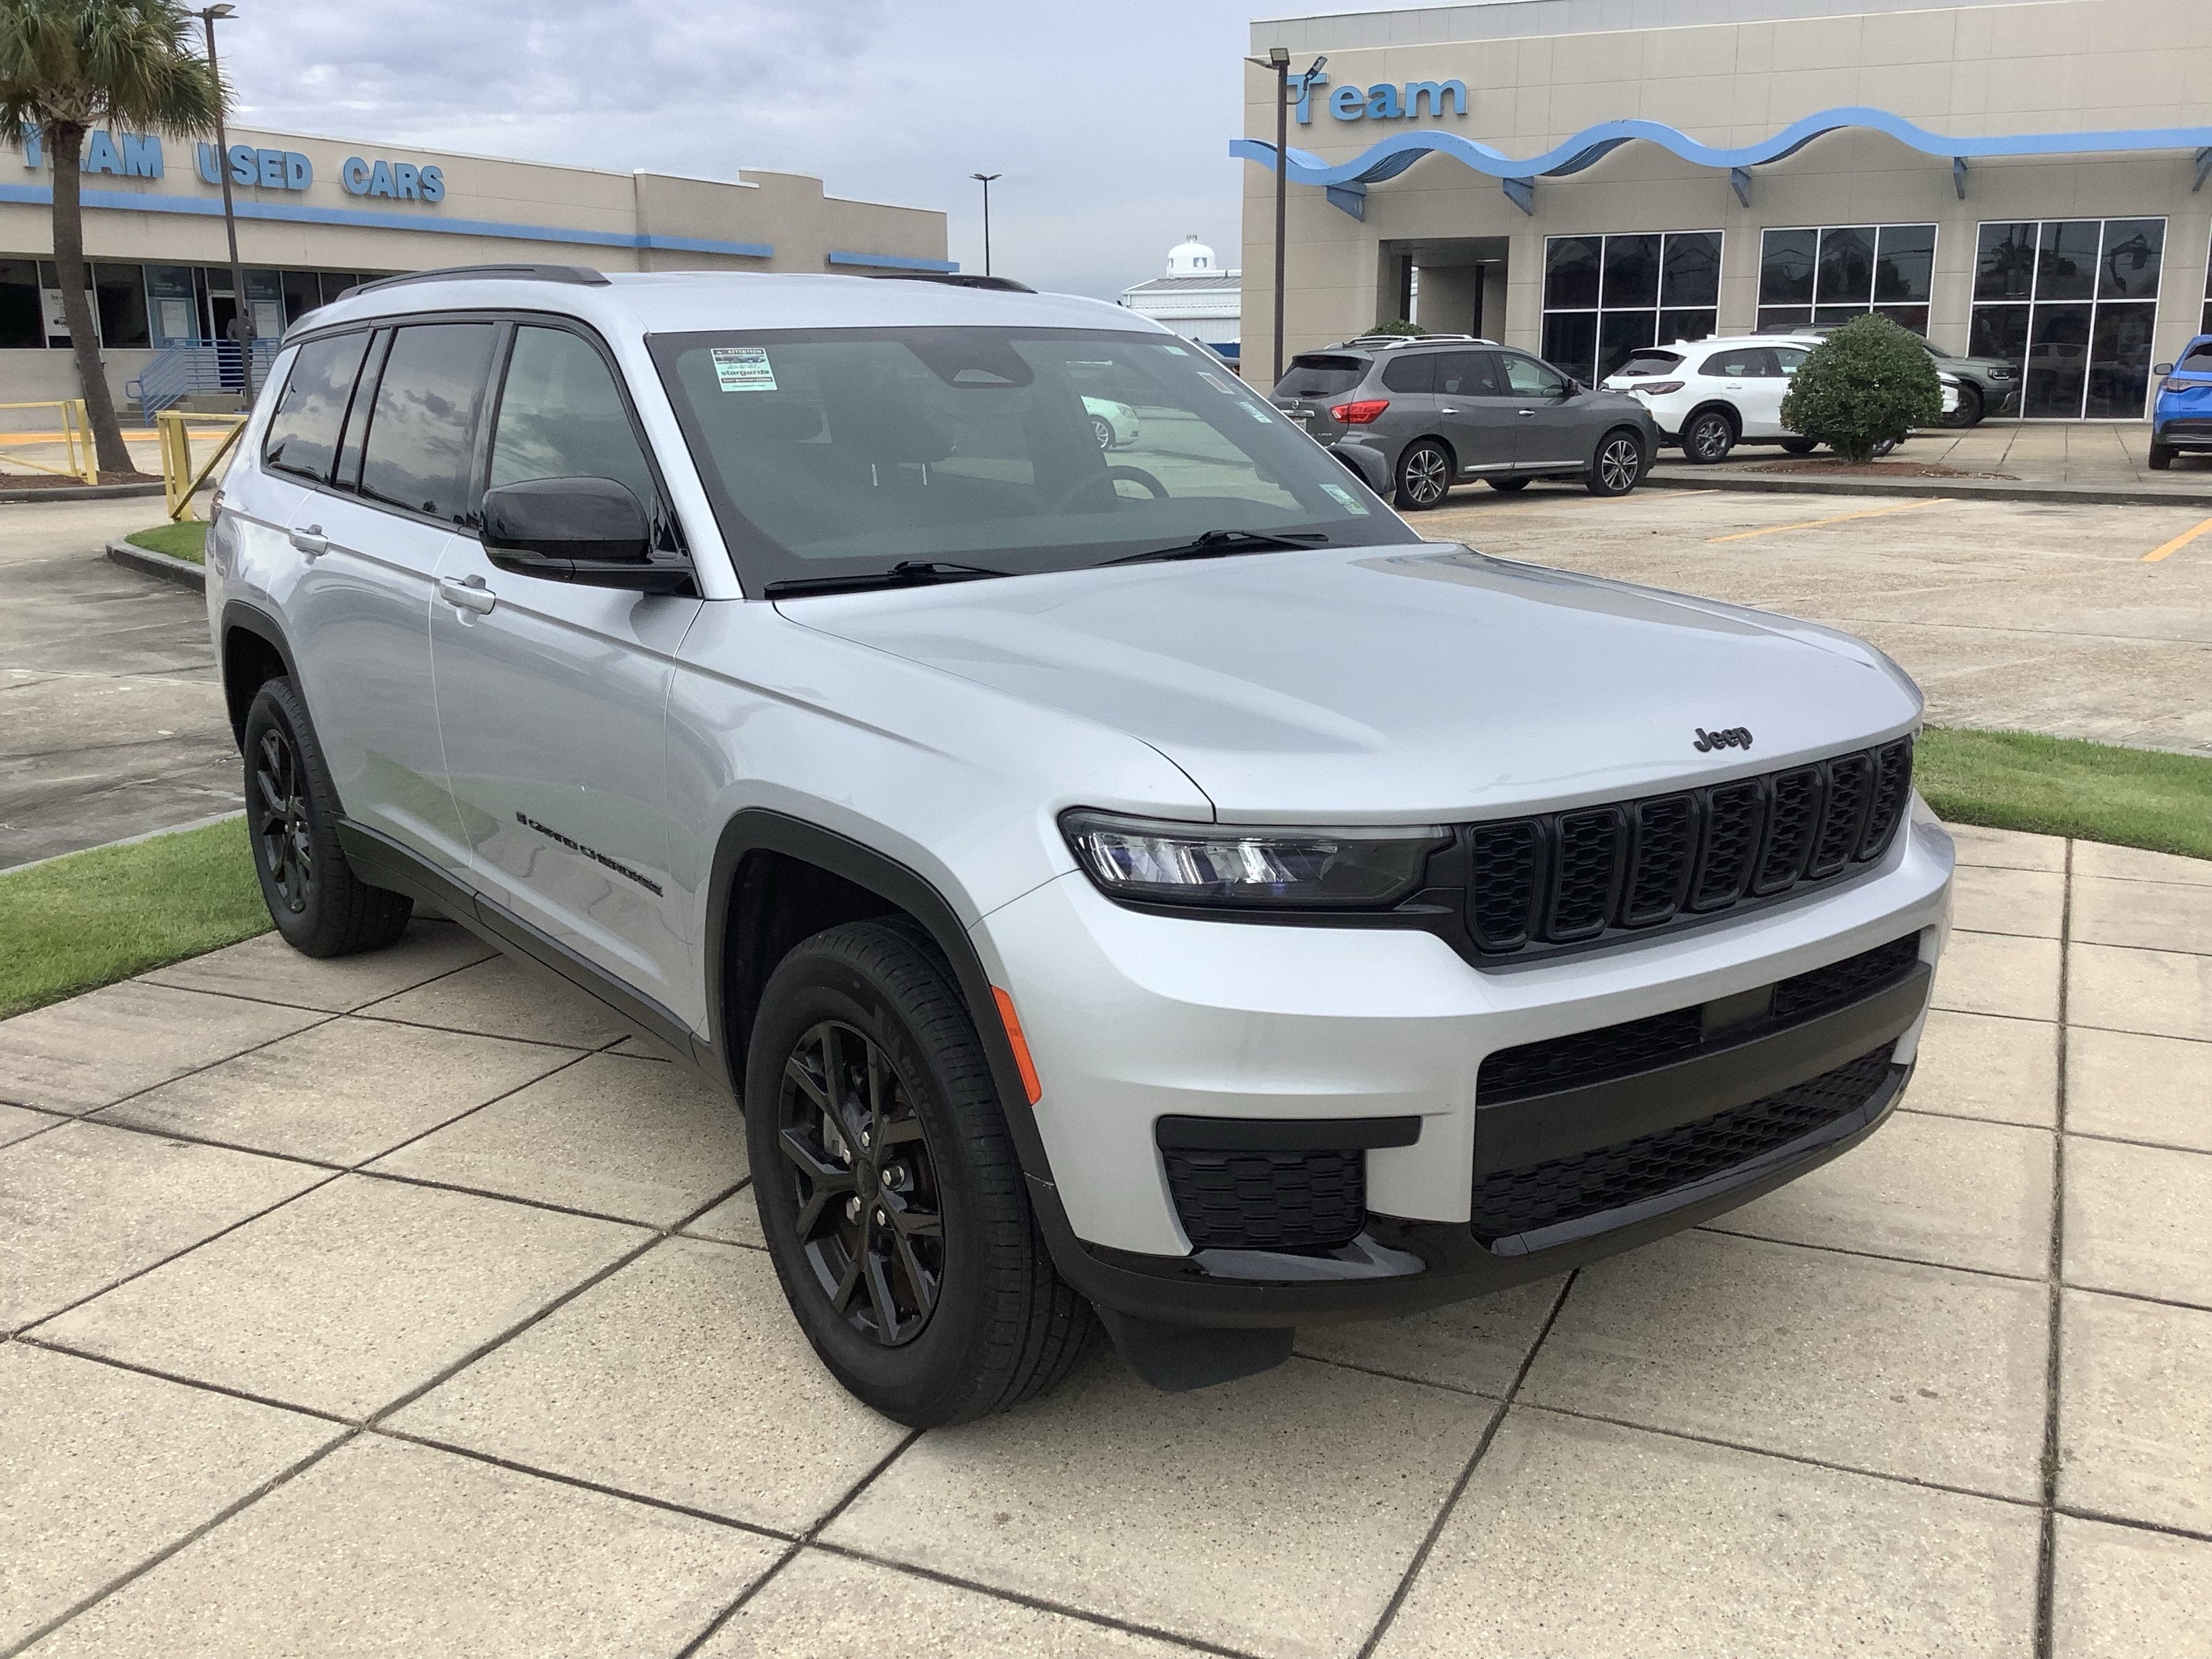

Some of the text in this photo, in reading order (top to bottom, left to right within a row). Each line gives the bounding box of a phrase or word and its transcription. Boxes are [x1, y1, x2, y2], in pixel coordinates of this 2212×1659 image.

[1287, 73, 1467, 124] Team
[22, 122, 445, 203] TAM USED CARS
[1693, 726, 1753, 752] Jeep
